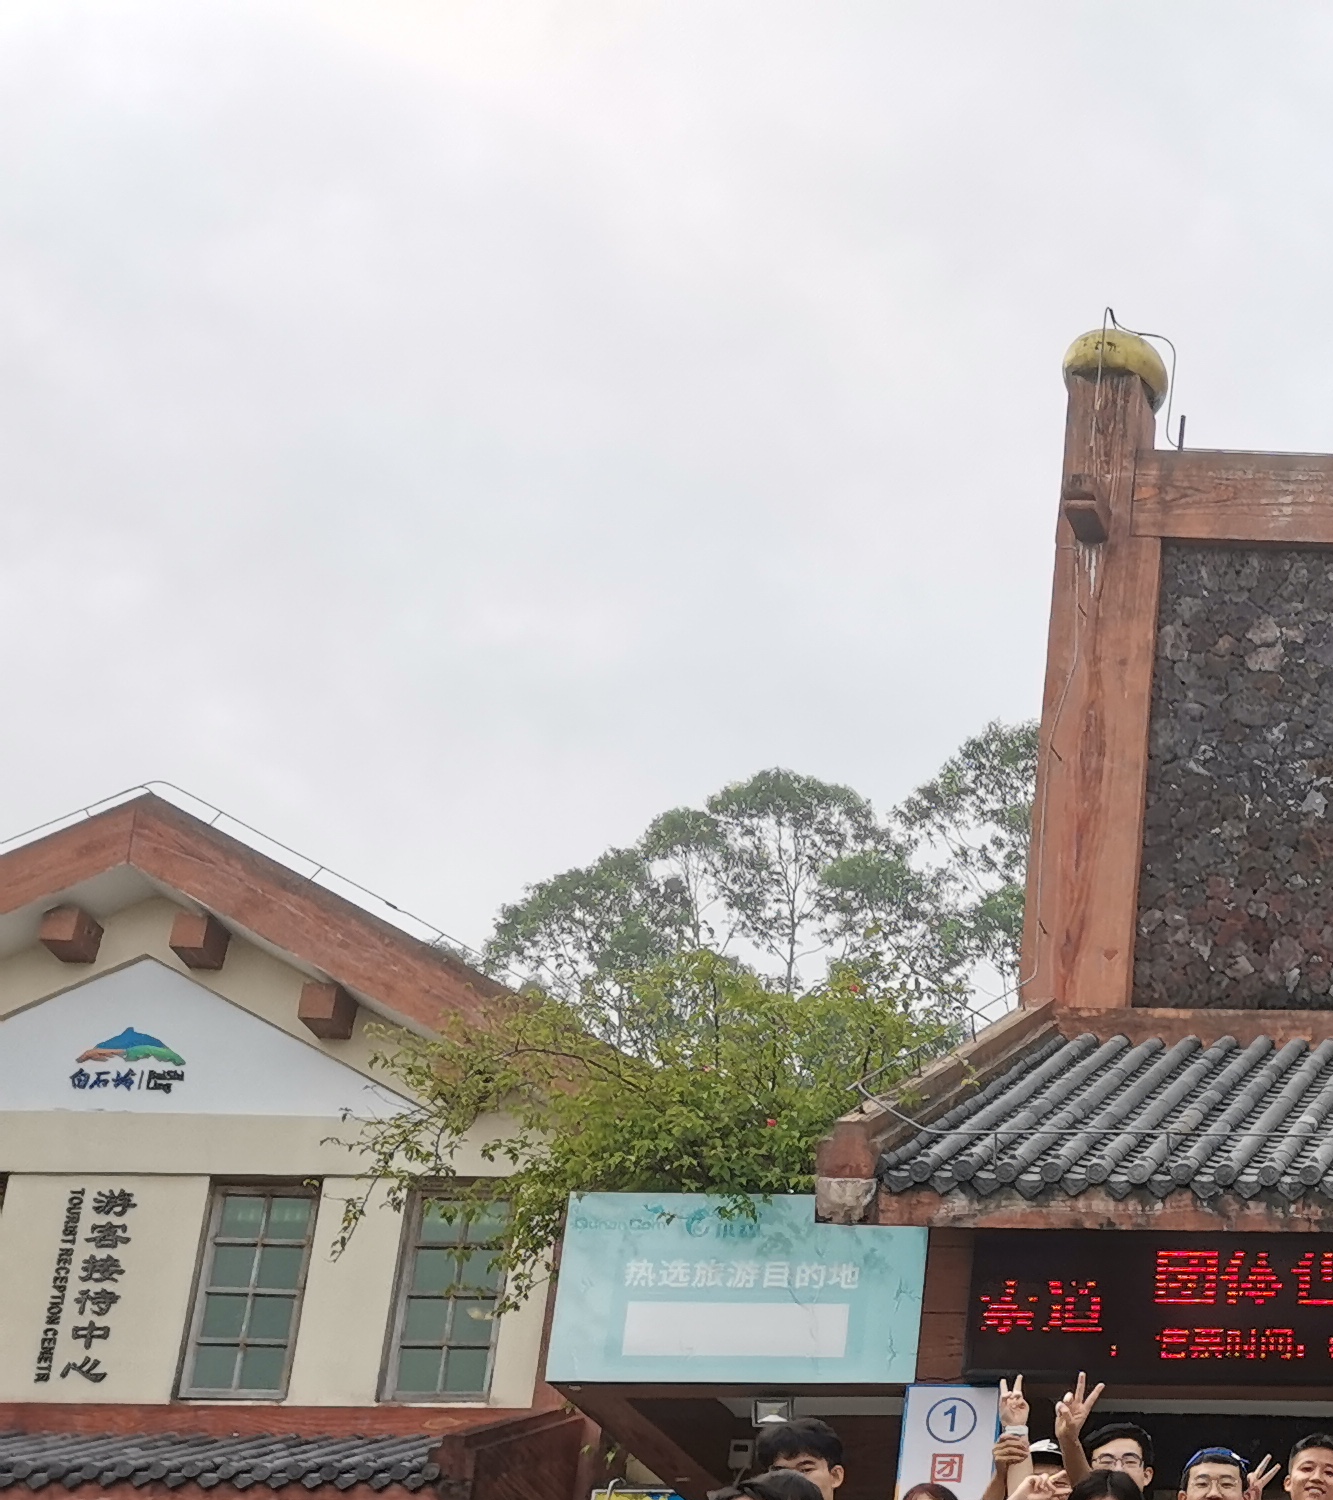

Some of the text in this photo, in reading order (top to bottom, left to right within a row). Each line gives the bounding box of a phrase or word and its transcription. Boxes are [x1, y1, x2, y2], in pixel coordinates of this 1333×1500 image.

[69, 1067, 137, 1092] 白石岭
[60, 1187, 86, 1245] TOURIST
[45, 1247, 75, 1325] RECEPTION
[60, 1188, 138, 1384] 游客接待中心
[624, 1259, 860, 1290] 热选旅游目的地
